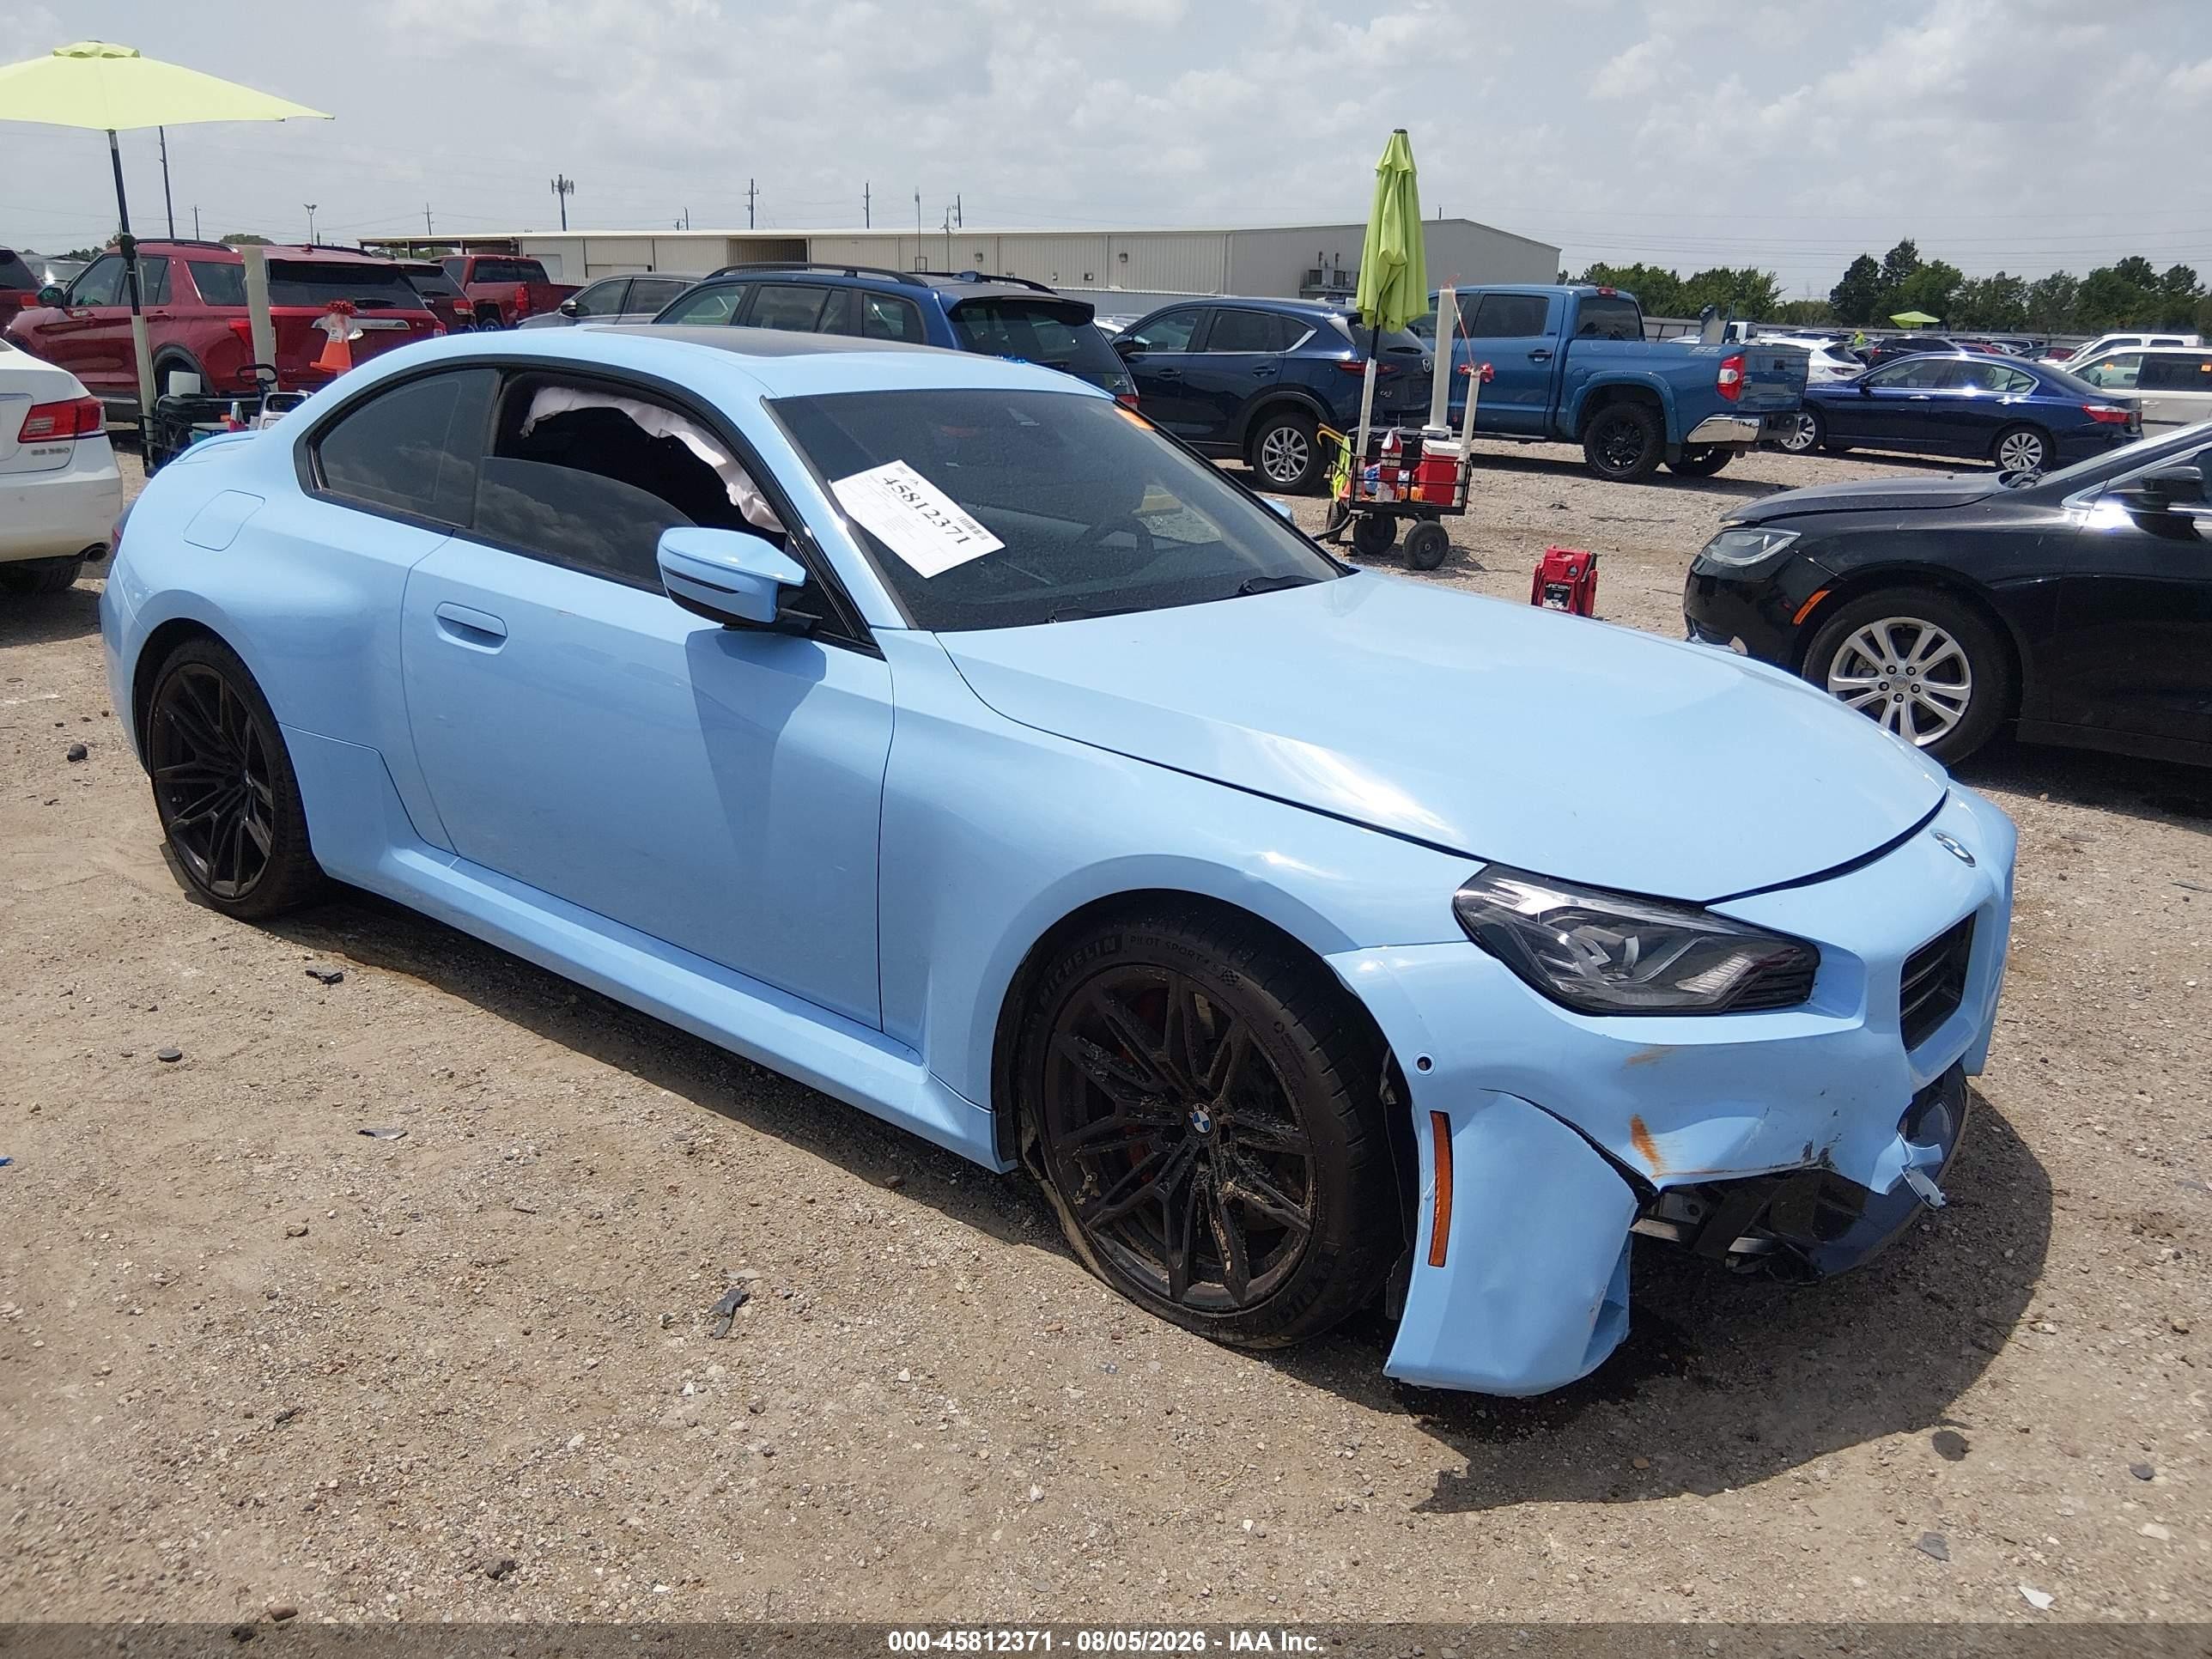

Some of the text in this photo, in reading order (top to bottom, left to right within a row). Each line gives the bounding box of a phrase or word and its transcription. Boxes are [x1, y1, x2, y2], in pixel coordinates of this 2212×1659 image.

[883, 477, 971, 544] 45812371
[1038, 934, 1122, 1008] MICHELIN
[1167, 941, 1204, 962] SPORT
